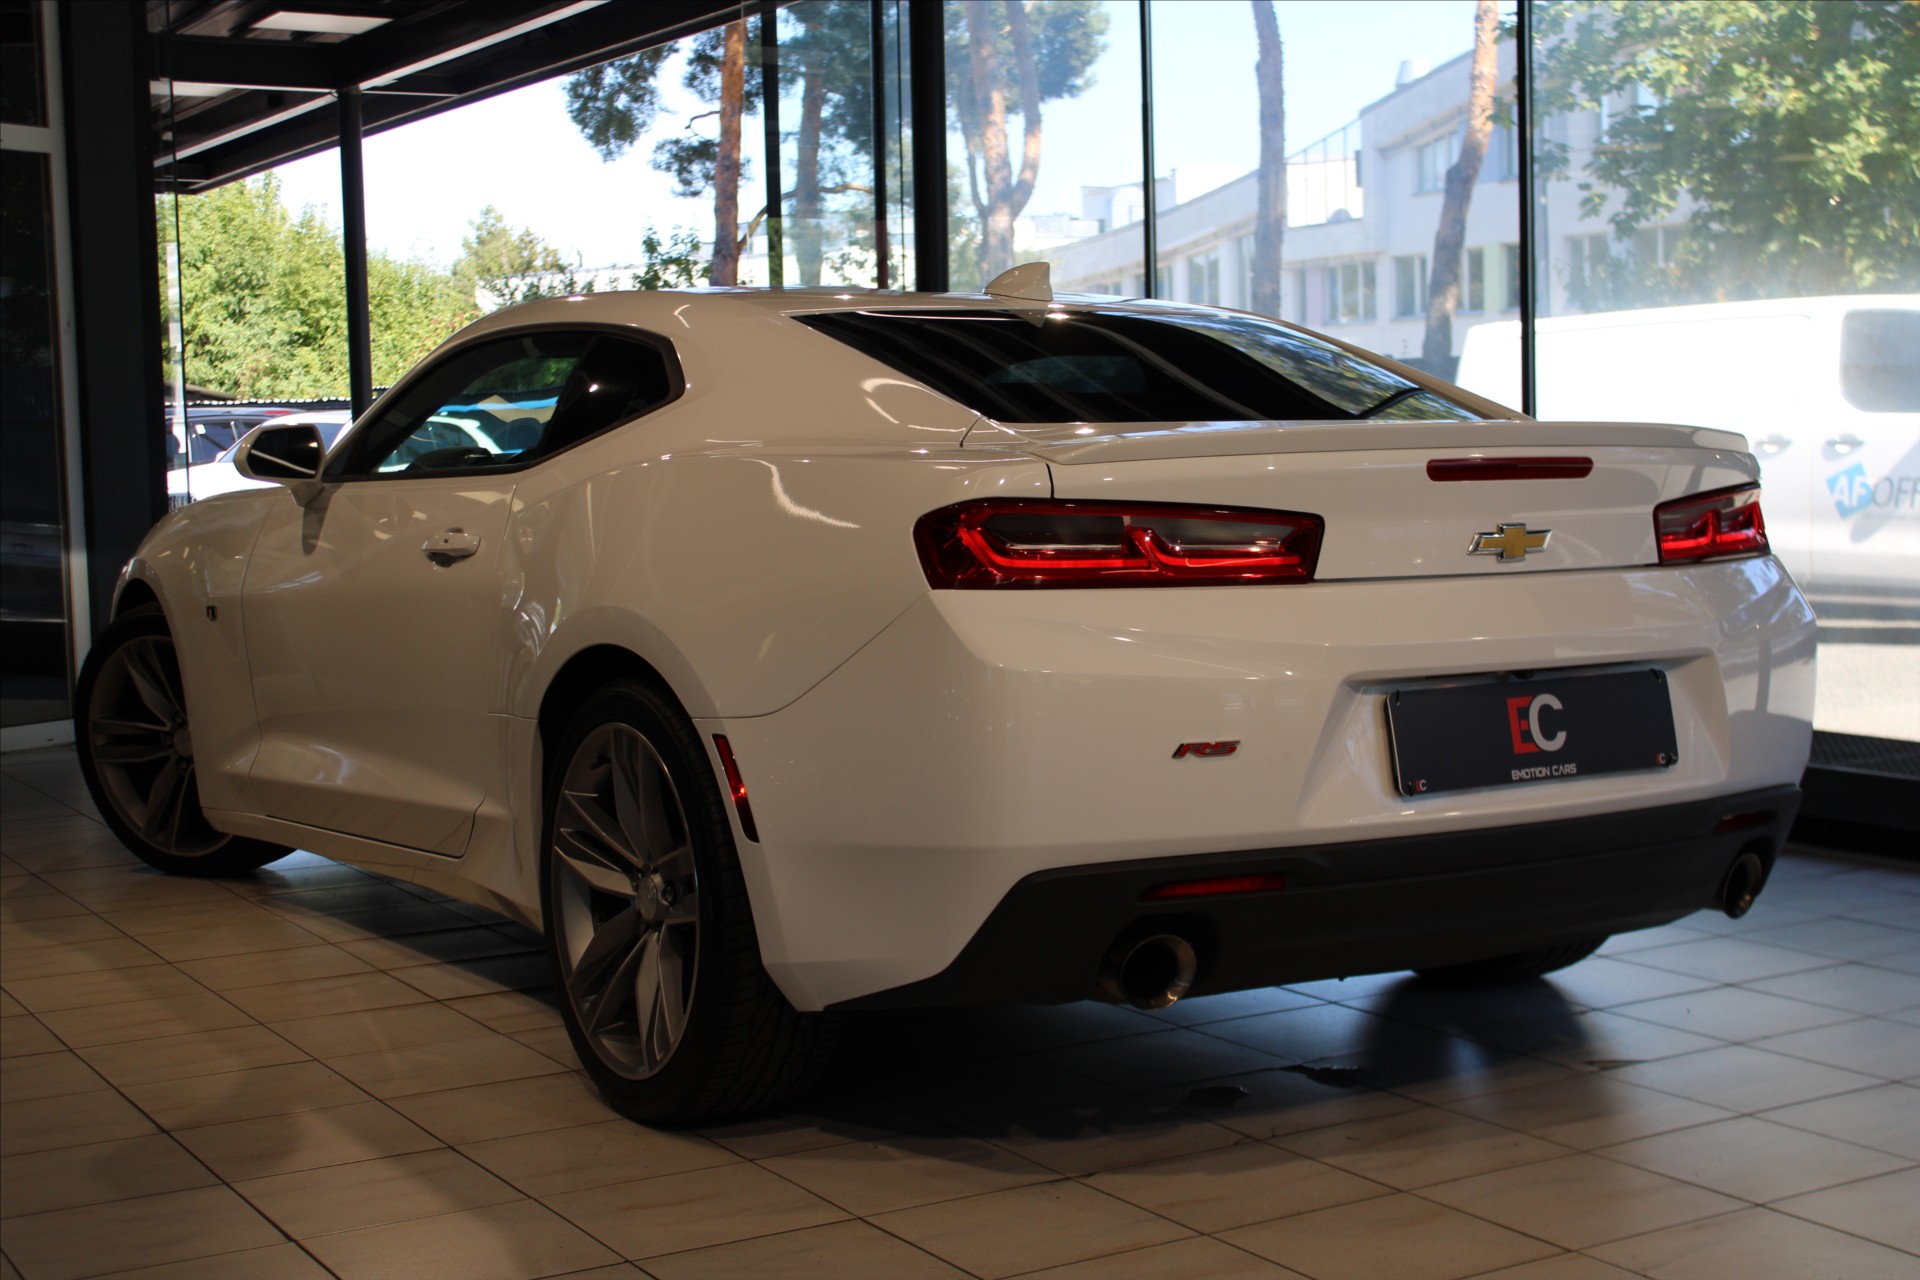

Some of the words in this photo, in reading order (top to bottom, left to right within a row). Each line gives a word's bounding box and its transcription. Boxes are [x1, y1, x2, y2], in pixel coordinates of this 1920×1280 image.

[1506, 693, 1567, 755] EC
[1171, 739, 1241, 759] RS
[1511, 766, 1551, 781] EMOTION
[1552, 763, 1577, 777] CARS
